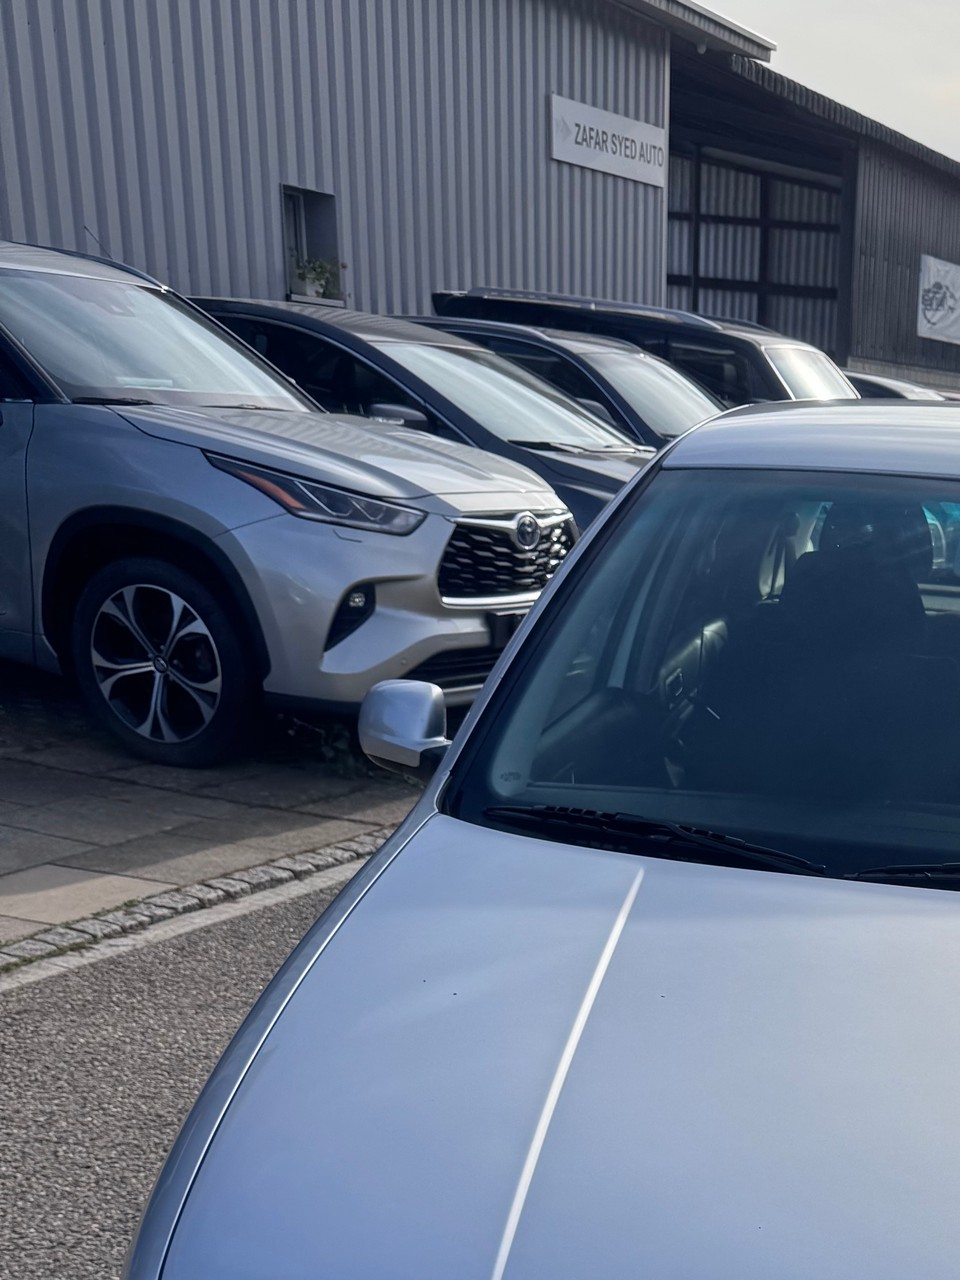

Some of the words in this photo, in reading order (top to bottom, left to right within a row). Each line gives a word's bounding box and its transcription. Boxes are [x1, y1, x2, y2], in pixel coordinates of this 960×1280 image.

[574, 123, 609, 154] ZAFAR
[611, 134, 636, 160] SYED
[639, 141, 664, 168] AUTO
